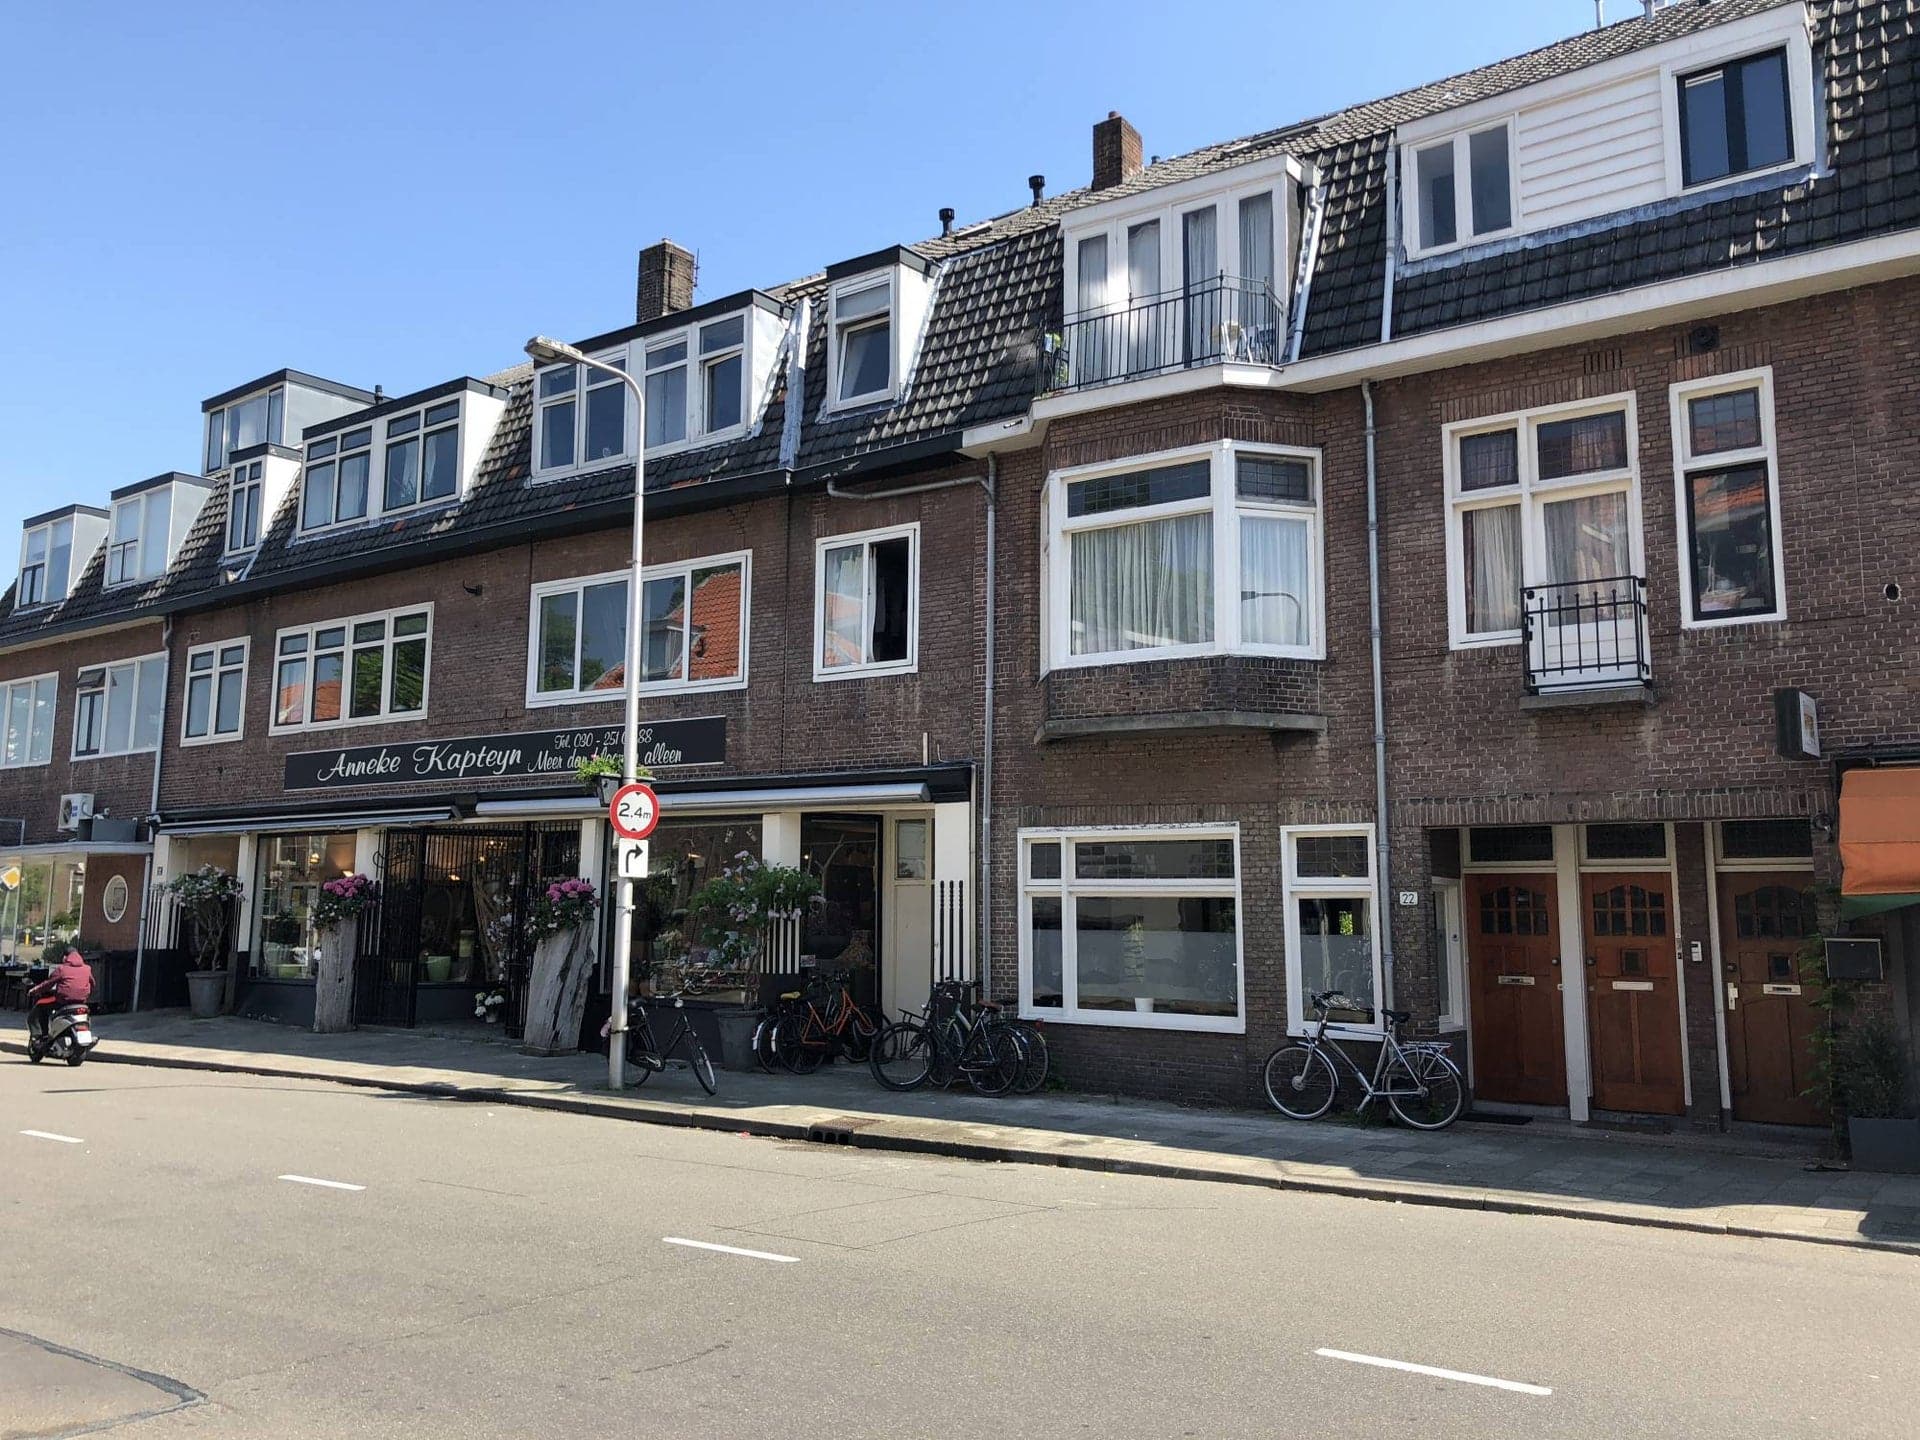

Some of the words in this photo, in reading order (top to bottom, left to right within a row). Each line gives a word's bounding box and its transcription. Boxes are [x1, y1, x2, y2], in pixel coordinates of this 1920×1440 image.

[573, 732, 594, 748] 030
[603, 731, 620, 746] 251
[317, 748, 401, 781] Anneke
[412, 743, 522, 777] Kapteyn
[527, 750, 563, 773] Meer
[644, 742, 682, 765] alleen
[1402, 893, 1415, 904] 22
